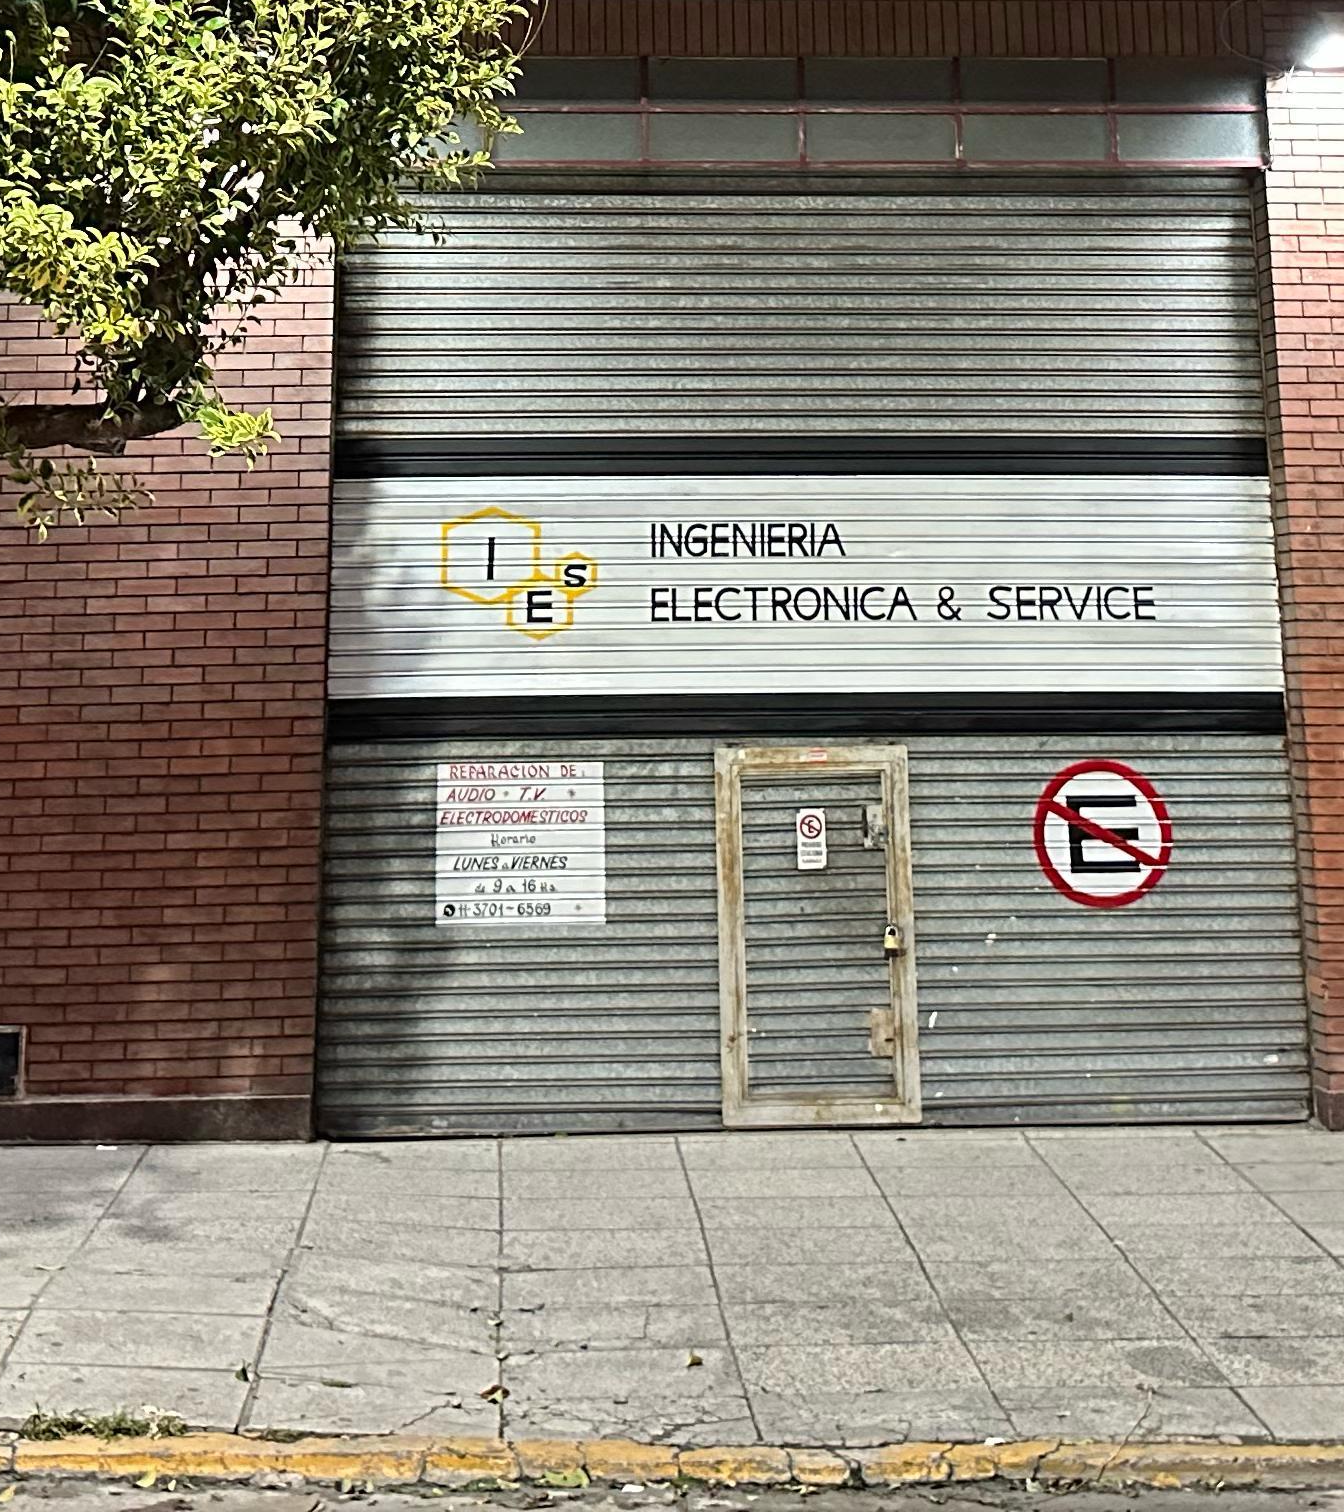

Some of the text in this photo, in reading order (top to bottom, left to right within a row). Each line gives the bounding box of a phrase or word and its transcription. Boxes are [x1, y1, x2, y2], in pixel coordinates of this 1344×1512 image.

[651, 523, 846, 558] INGENIERIA
[487, 537, 496, 580] I
[563, 564, 588, 588] S
[526, 590, 553, 623] E
[651, 586, 1156, 622] ELECTRONICA & SERVICE
[449, 764, 577, 780] REPARACION DE
[446, 788, 496, 802] AUDIO
[440, 809, 588, 825] ELECTRODOMESTICOS
[491, 833, 536, 847] Horario
[1066, 795, 1141, 873] E
[453, 856, 500, 871] LUNES
[511, 855, 568, 870] VIERNES
[493, 878, 503, 893] 9
[522, 878, 537, 892] 16
